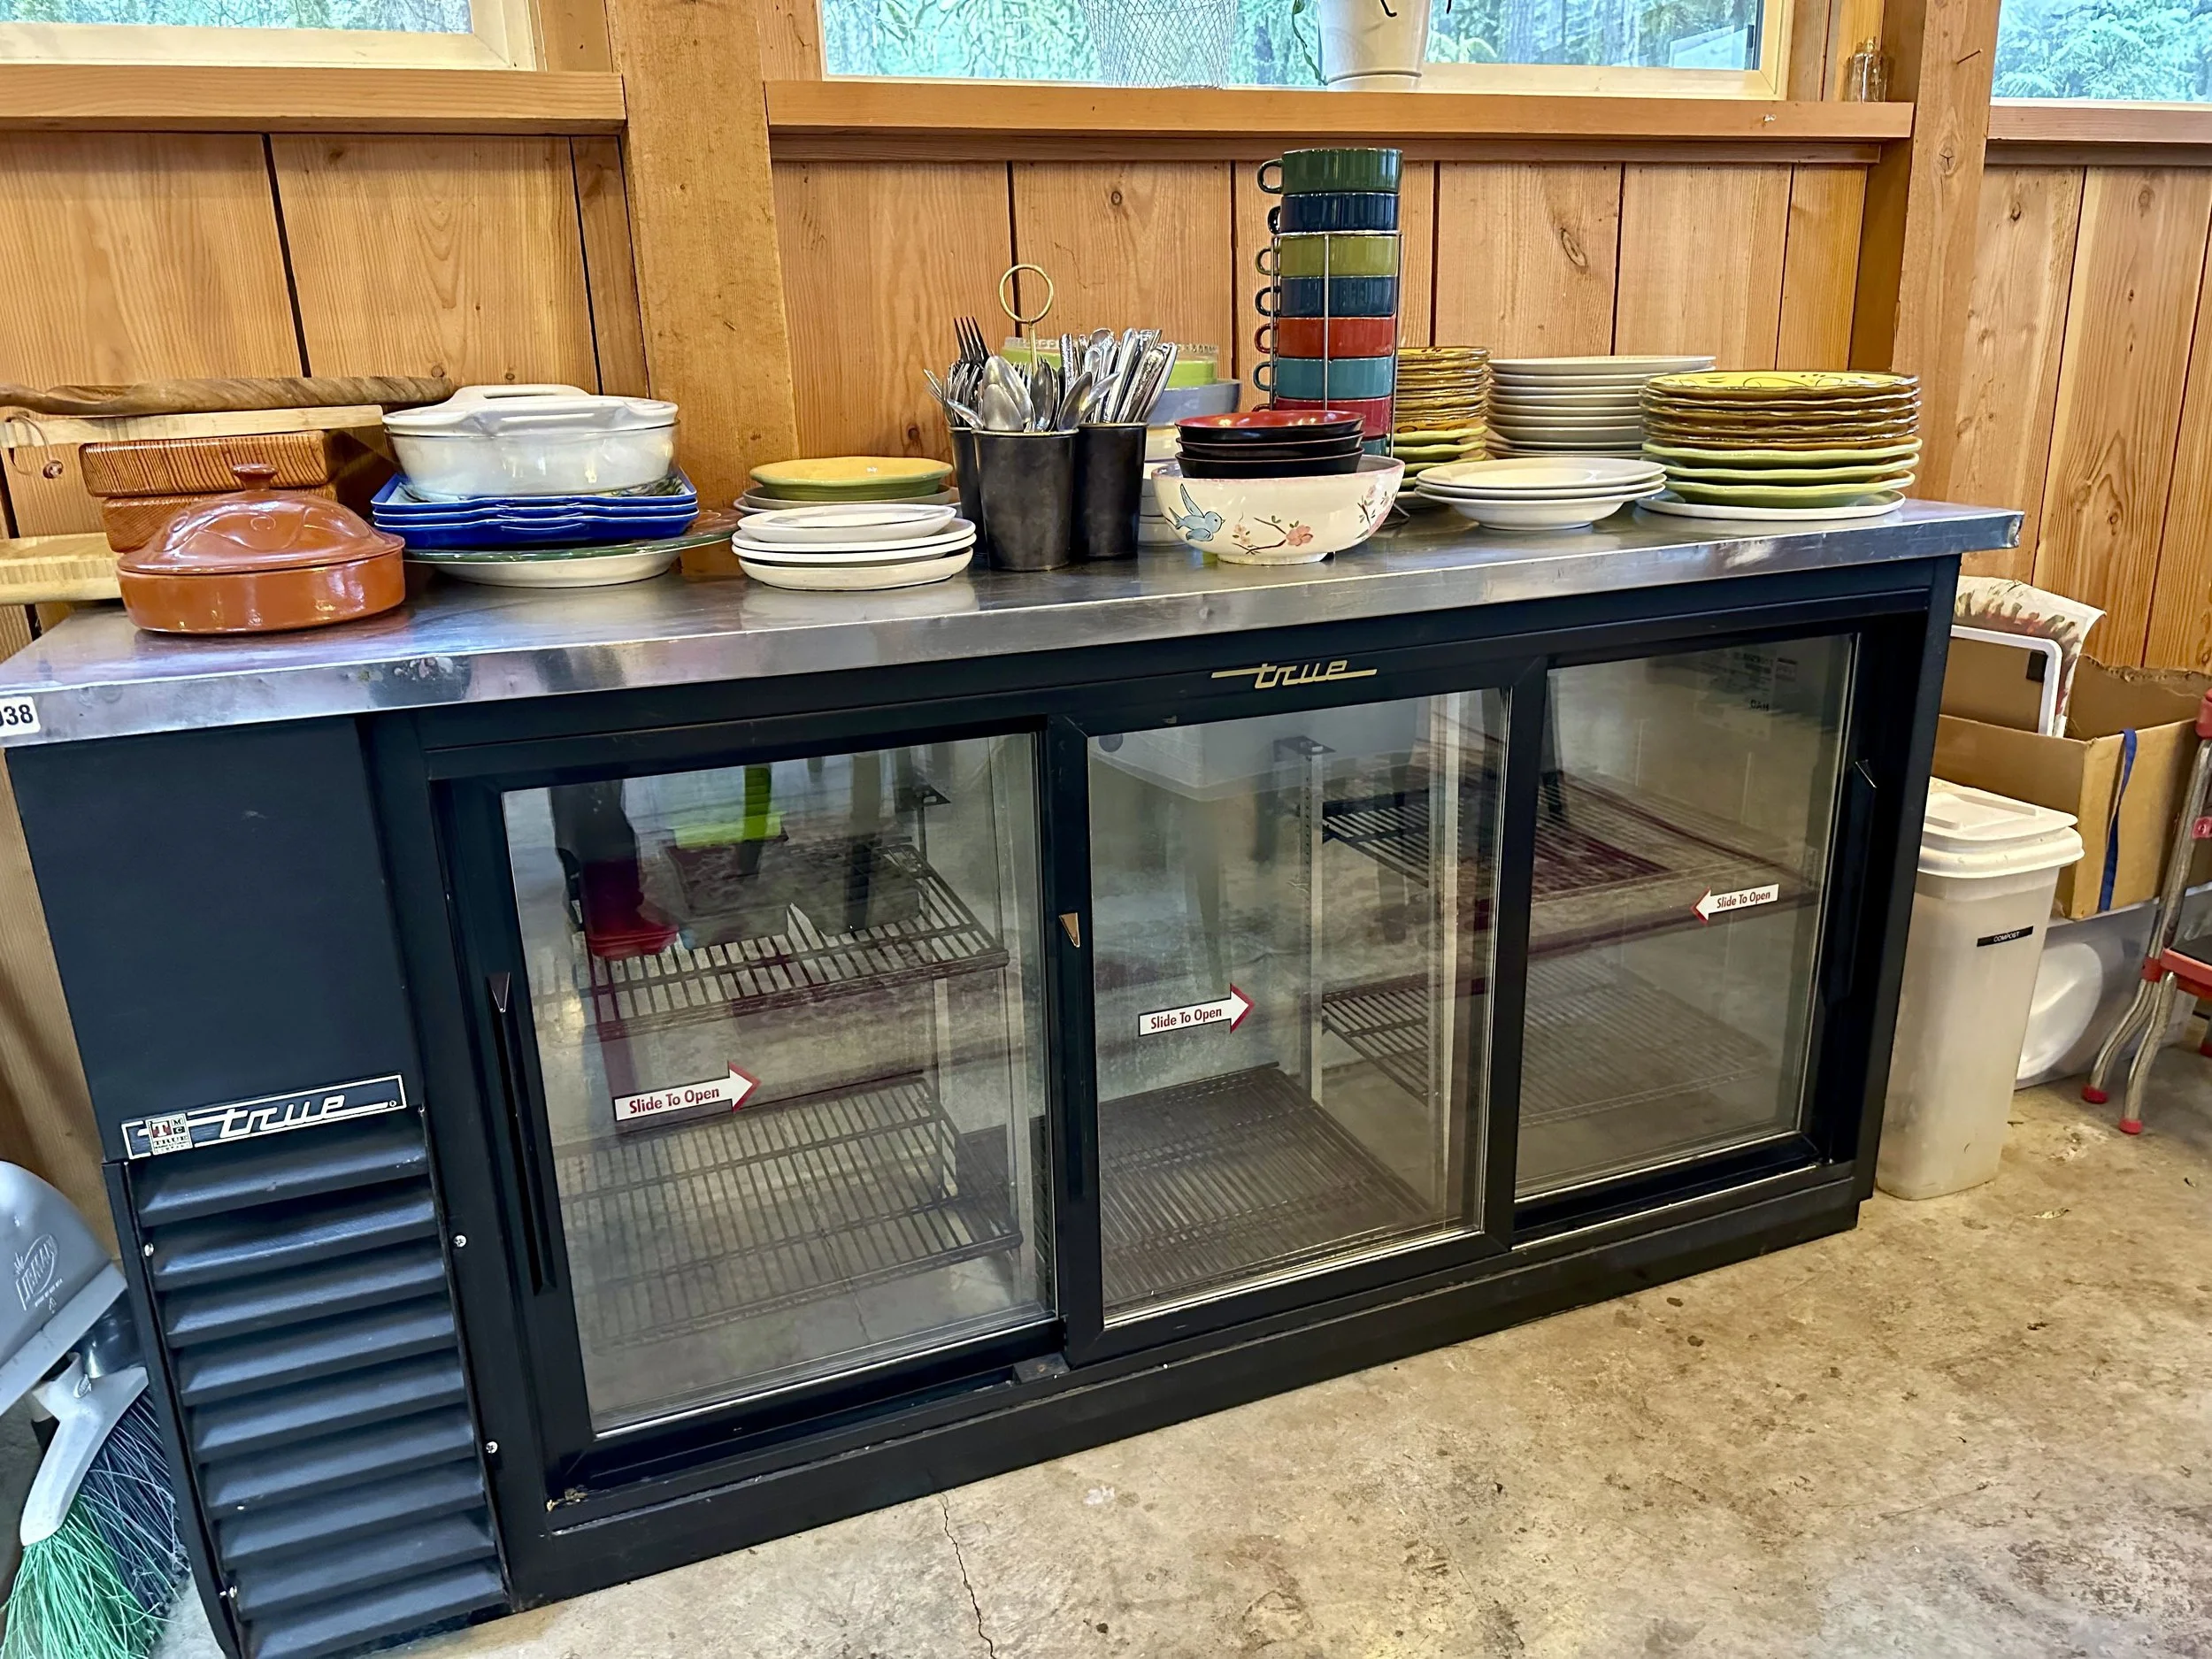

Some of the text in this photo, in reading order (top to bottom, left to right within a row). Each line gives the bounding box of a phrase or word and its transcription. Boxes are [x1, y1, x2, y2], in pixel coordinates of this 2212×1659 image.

[1255, 660, 1348, 689] true
[1717, 891, 1770, 909] Slide To Open
[1993, 931, 2020, 942] COMPOST
[1150, 1008, 1222, 1029] Slide To Open
[629, 1087, 719, 1114] Slide To Open
[219, 1094, 345, 1139] true
